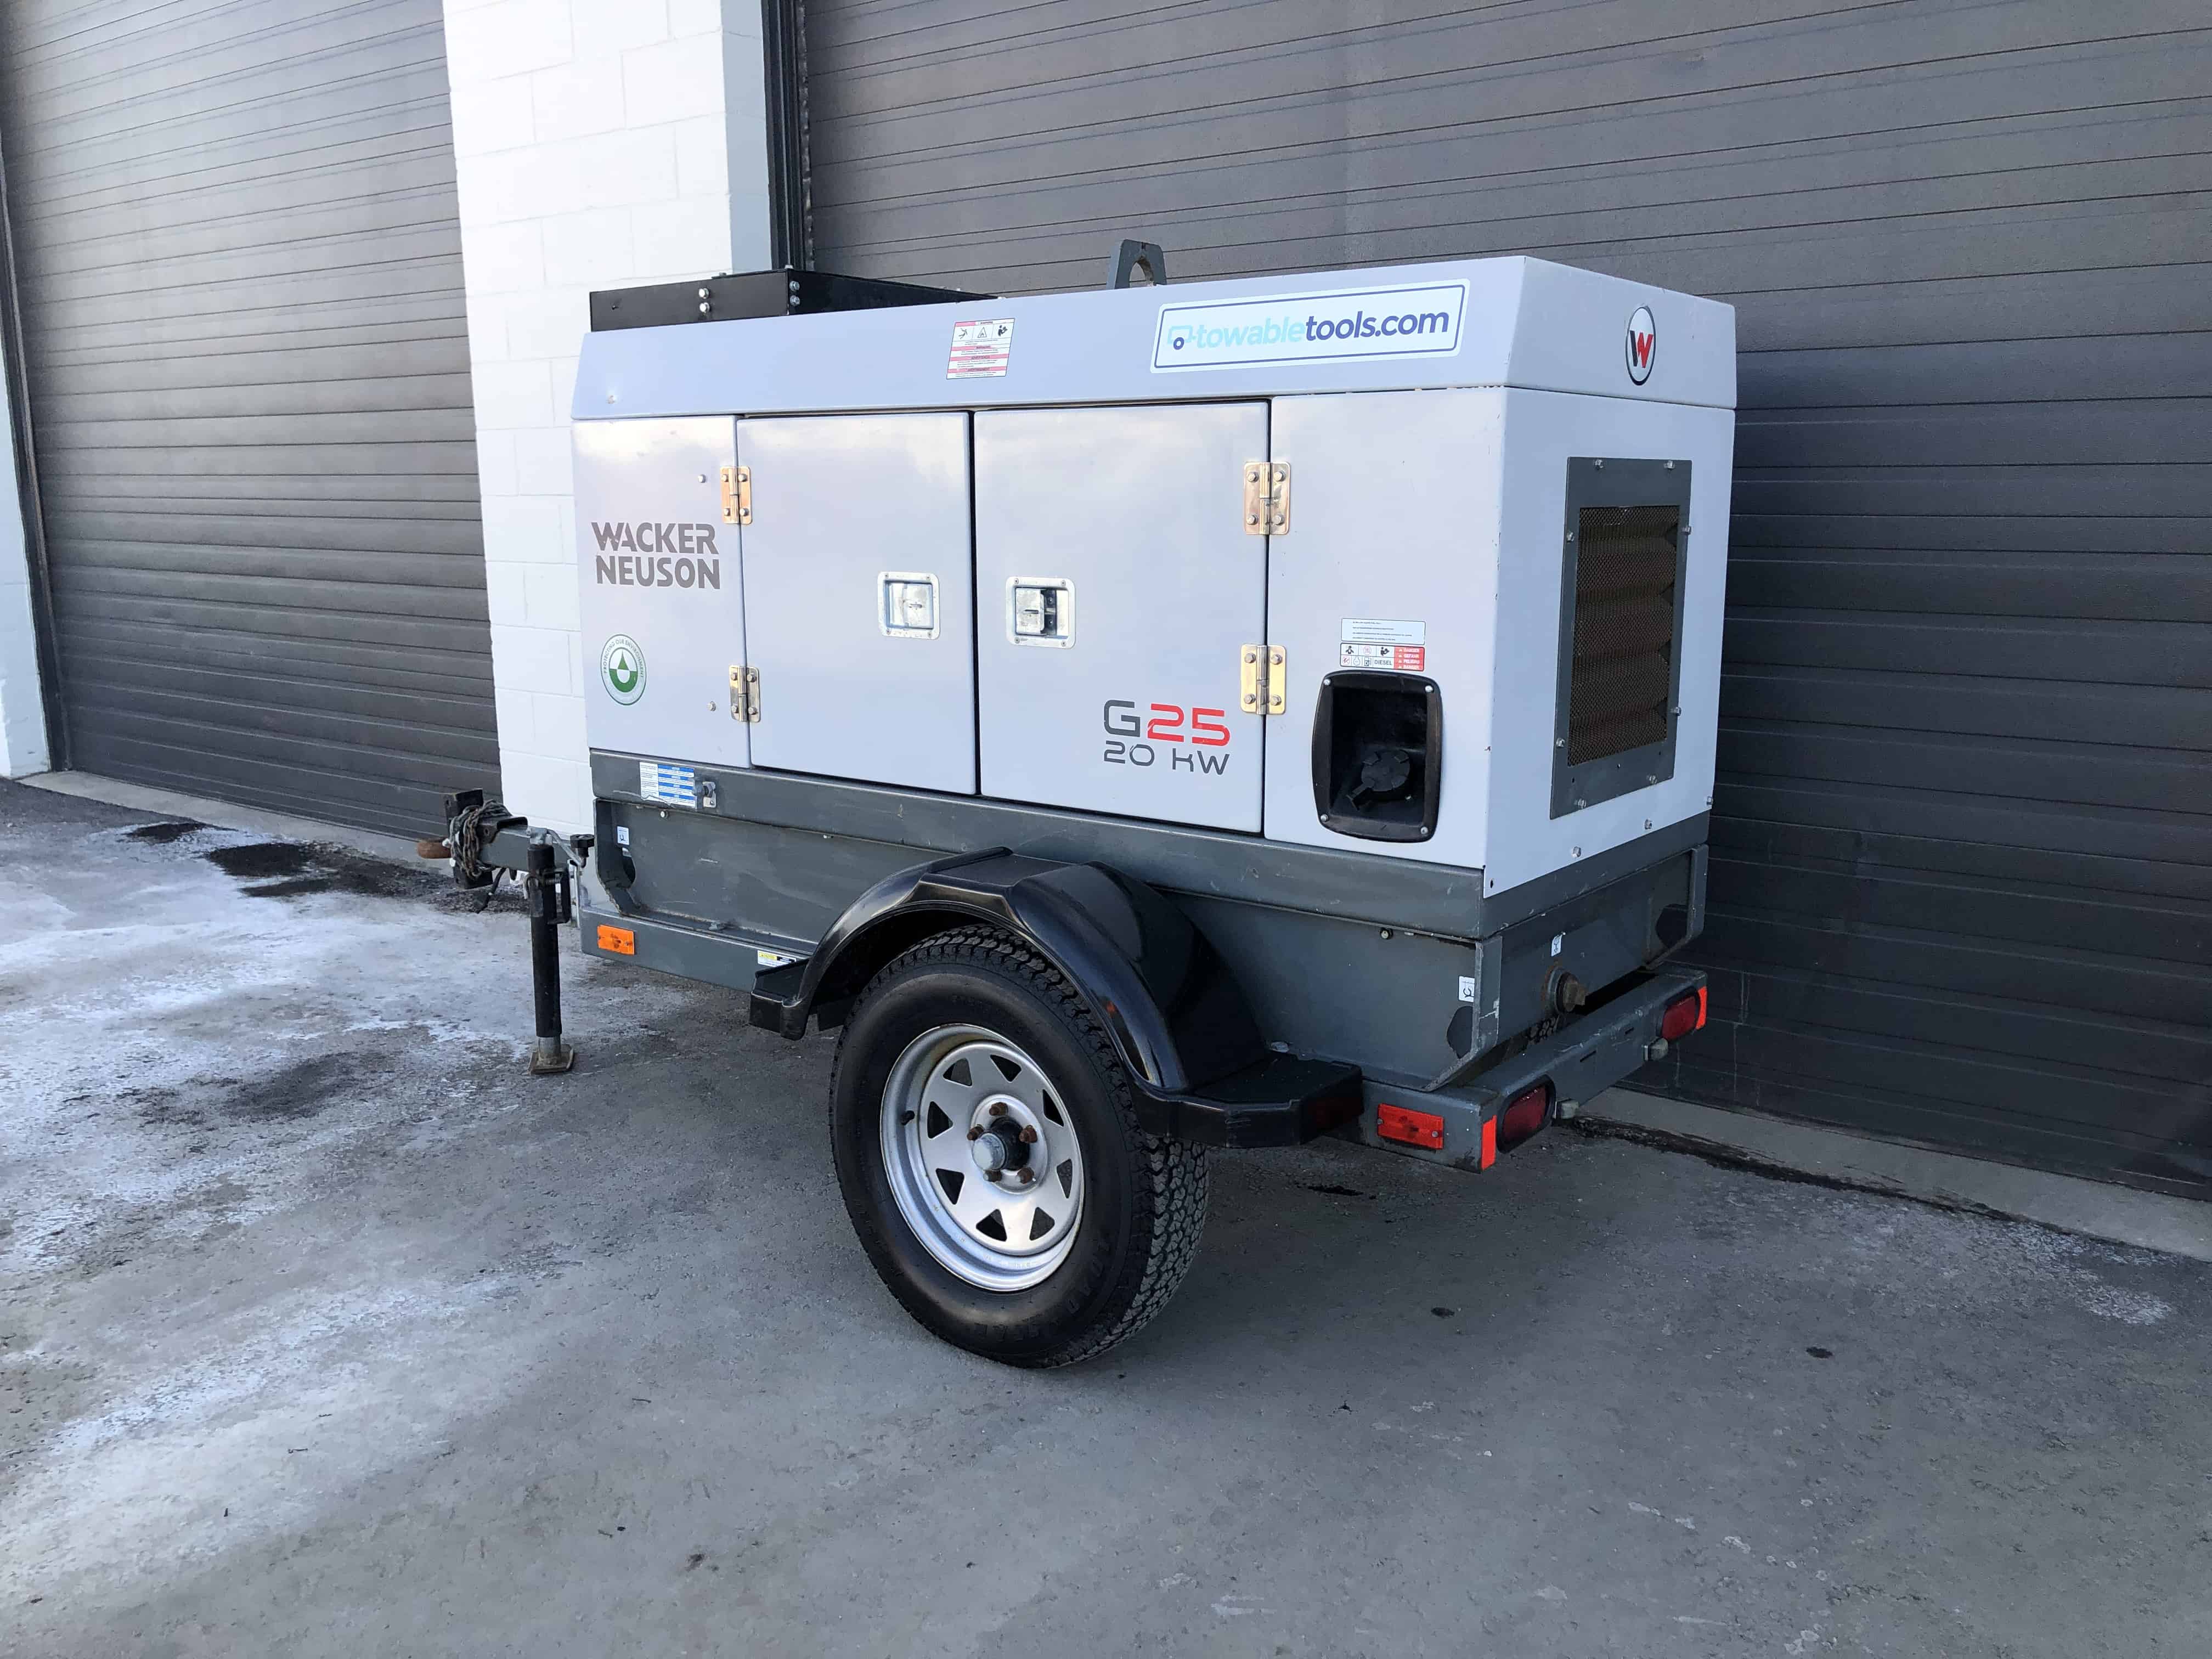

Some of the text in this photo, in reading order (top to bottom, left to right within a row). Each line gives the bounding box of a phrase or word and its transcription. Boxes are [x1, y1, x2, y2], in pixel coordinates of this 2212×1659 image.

[1196, 311, 1449, 349] towabletools.com
[1629, 330, 1654, 369] W
[591, 522, 719, 555] WACKER
[596, 555, 720, 590] NEUSON
[1104, 699, 1230, 747] G25
[1104, 740, 1155, 766] 20
